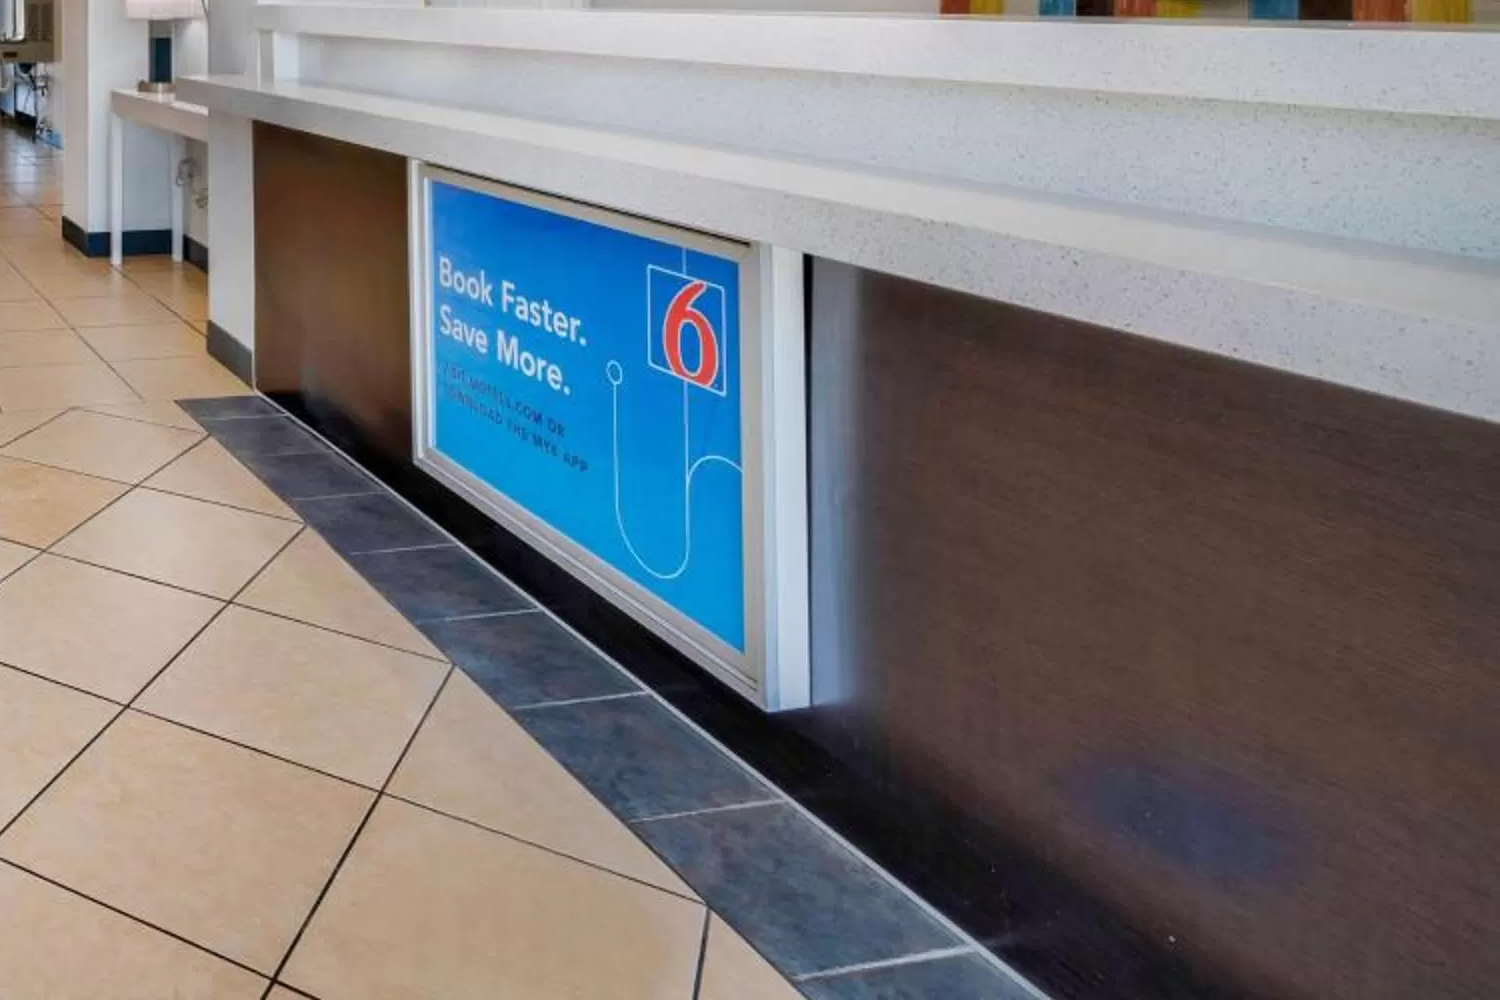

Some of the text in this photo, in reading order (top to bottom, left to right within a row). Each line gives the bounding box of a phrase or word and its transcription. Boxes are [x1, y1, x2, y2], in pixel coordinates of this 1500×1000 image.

[439, 256, 587, 346] Book Faster.
[662, 279, 719, 388] 6
[439, 304, 571, 396] Save More.
[507, 417, 529, 442] THE
[563, 453, 589, 473] APP
[547, 417, 565, 438] OR
